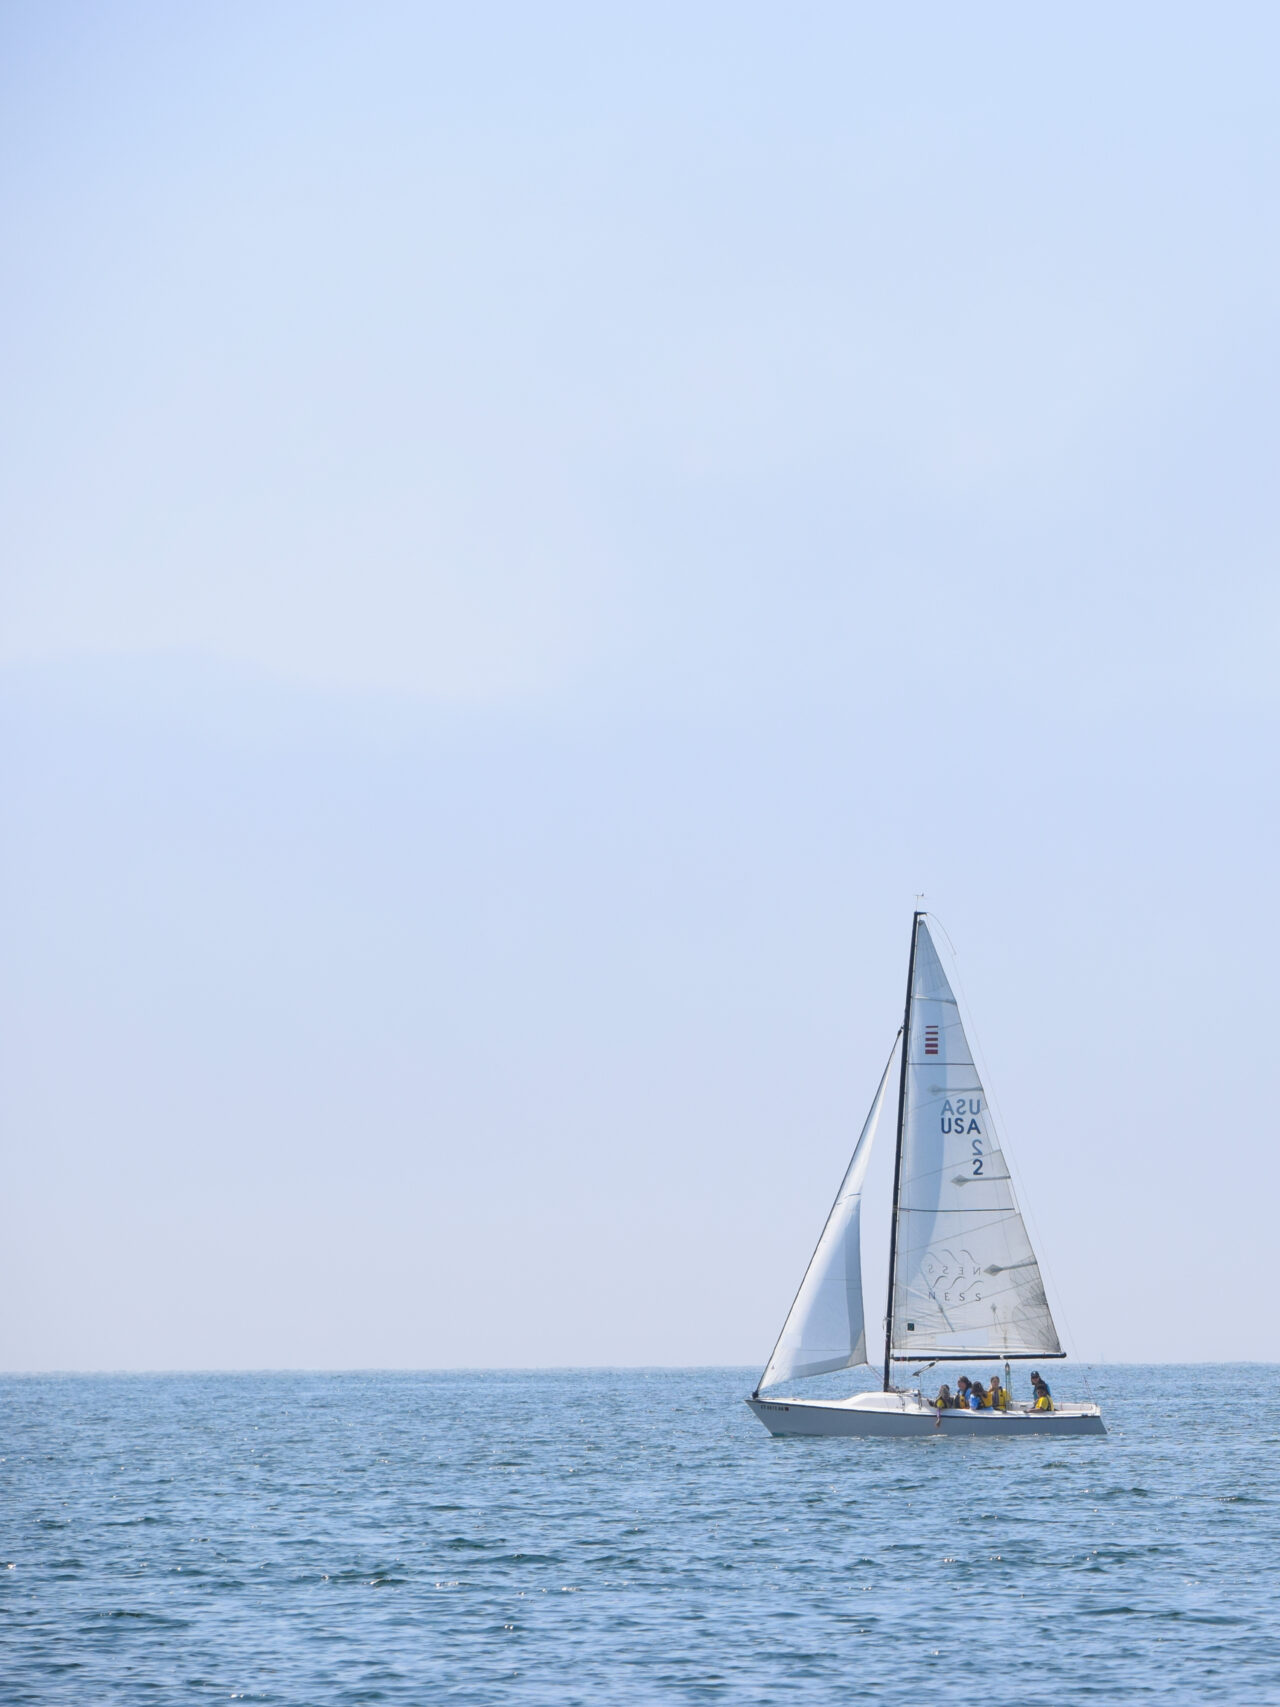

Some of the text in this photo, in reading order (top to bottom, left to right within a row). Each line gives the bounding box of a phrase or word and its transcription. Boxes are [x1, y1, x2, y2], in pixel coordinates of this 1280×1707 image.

[941, 1117, 981, 1134] USA
[973, 1159, 983, 1175] 2
[928, 1291, 983, 1302] NESS
